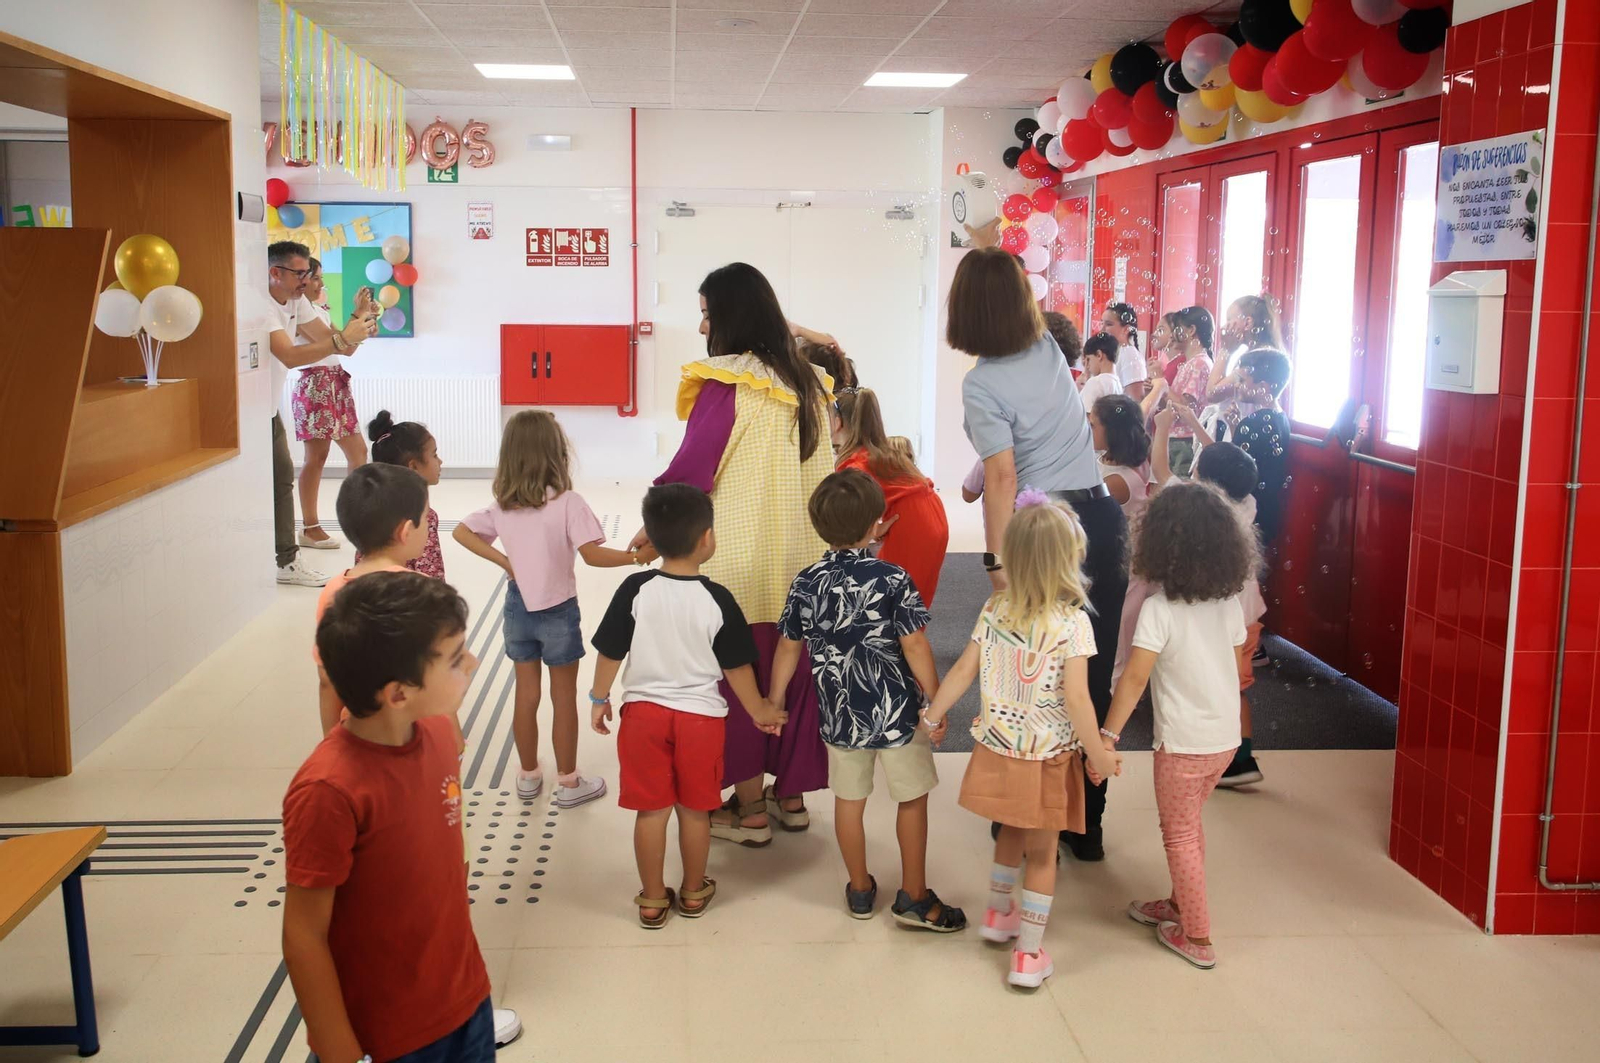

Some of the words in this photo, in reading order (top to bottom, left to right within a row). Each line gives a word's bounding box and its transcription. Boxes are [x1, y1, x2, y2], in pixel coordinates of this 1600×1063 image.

[1471, 150, 1481, 171] DE
[1482, 142, 1529, 169] SUGERENCIAS
[1448, 182, 1460, 192] NOS
[1462, 179, 1494, 192] ENCANTA
[1496, 176, 1512, 187] LEER
[1500, 189, 1522, 202] ENTRE
[1459, 207, 1481, 218] TODOS
[1489, 204, 1511, 216] TODAS
[1447, 221, 1480, 232] HAREMOS
[1481, 220, 1492, 230] UN
[1471, 234, 1496, 245] MEJOR
